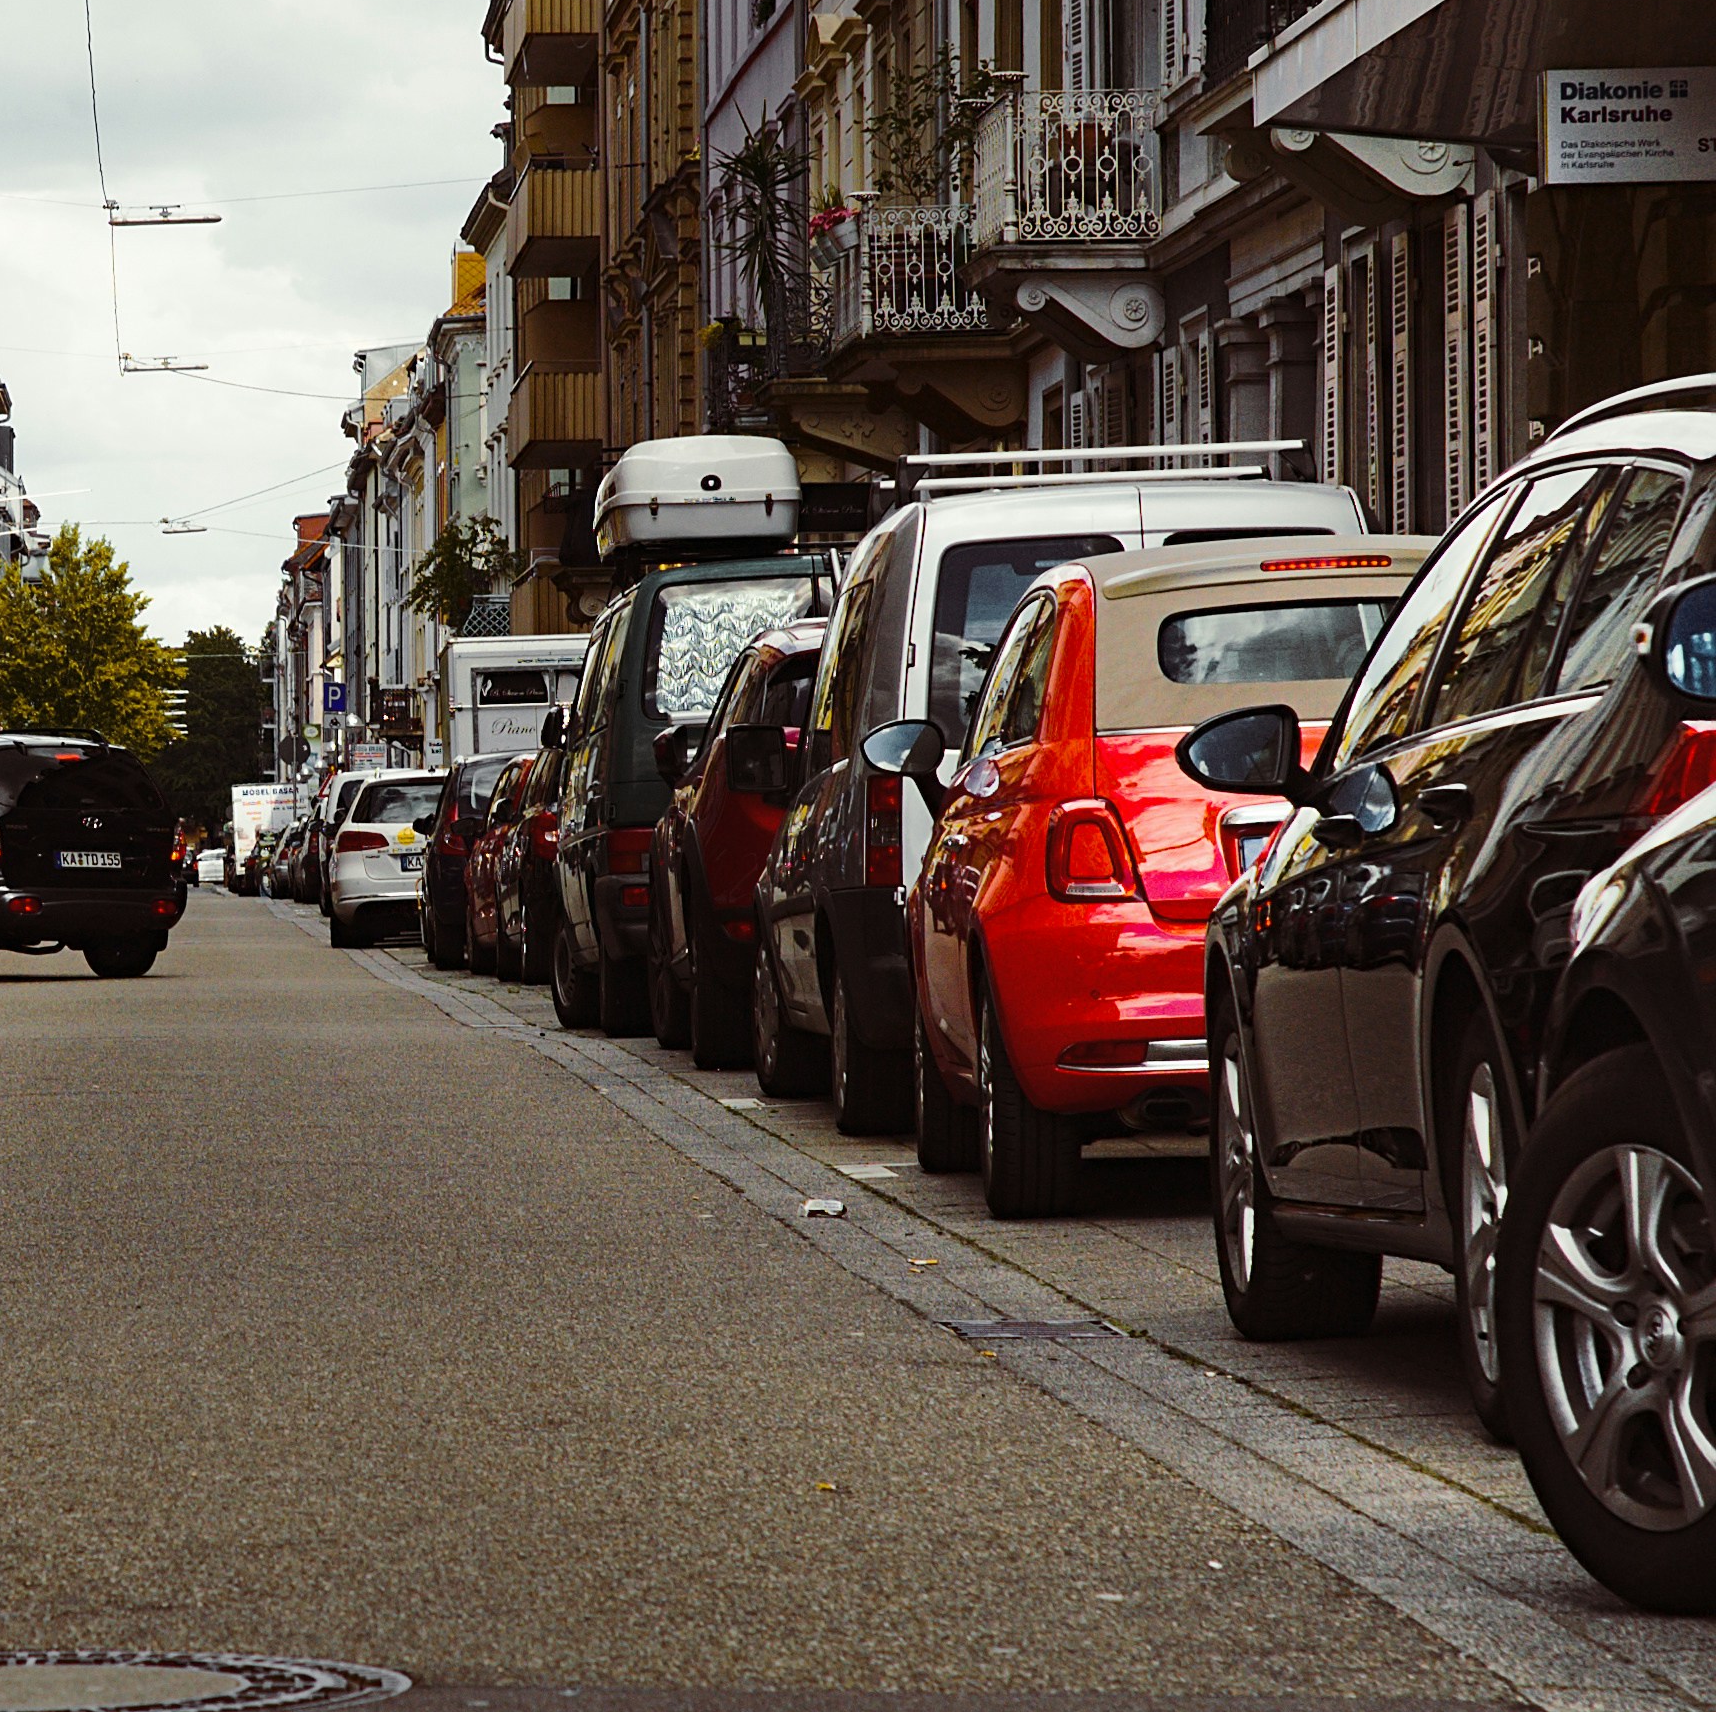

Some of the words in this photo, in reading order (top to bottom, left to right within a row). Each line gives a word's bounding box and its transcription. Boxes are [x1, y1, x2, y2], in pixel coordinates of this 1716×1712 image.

[1560, 81, 1664, 100] Diakonie
[1560, 105, 1673, 124] Karlsruhe
[1560, 140, 1579, 149] Das
[1581, 139, 1636, 149] Diakonische
[1637, 138, 1661, 148] Werk
[1560, 151, 1576, 160] der
[1644, 149, 1675, 158] Kirche
[1571, 160, 1616, 169] Karlsruhe
[328, 686, 341, 709] P
[491, 715, 536, 736] Piano
[61, 852, 77, 866] KA
[84, 853, 99, 866] TD
[100, 853, 121, 867] 155
